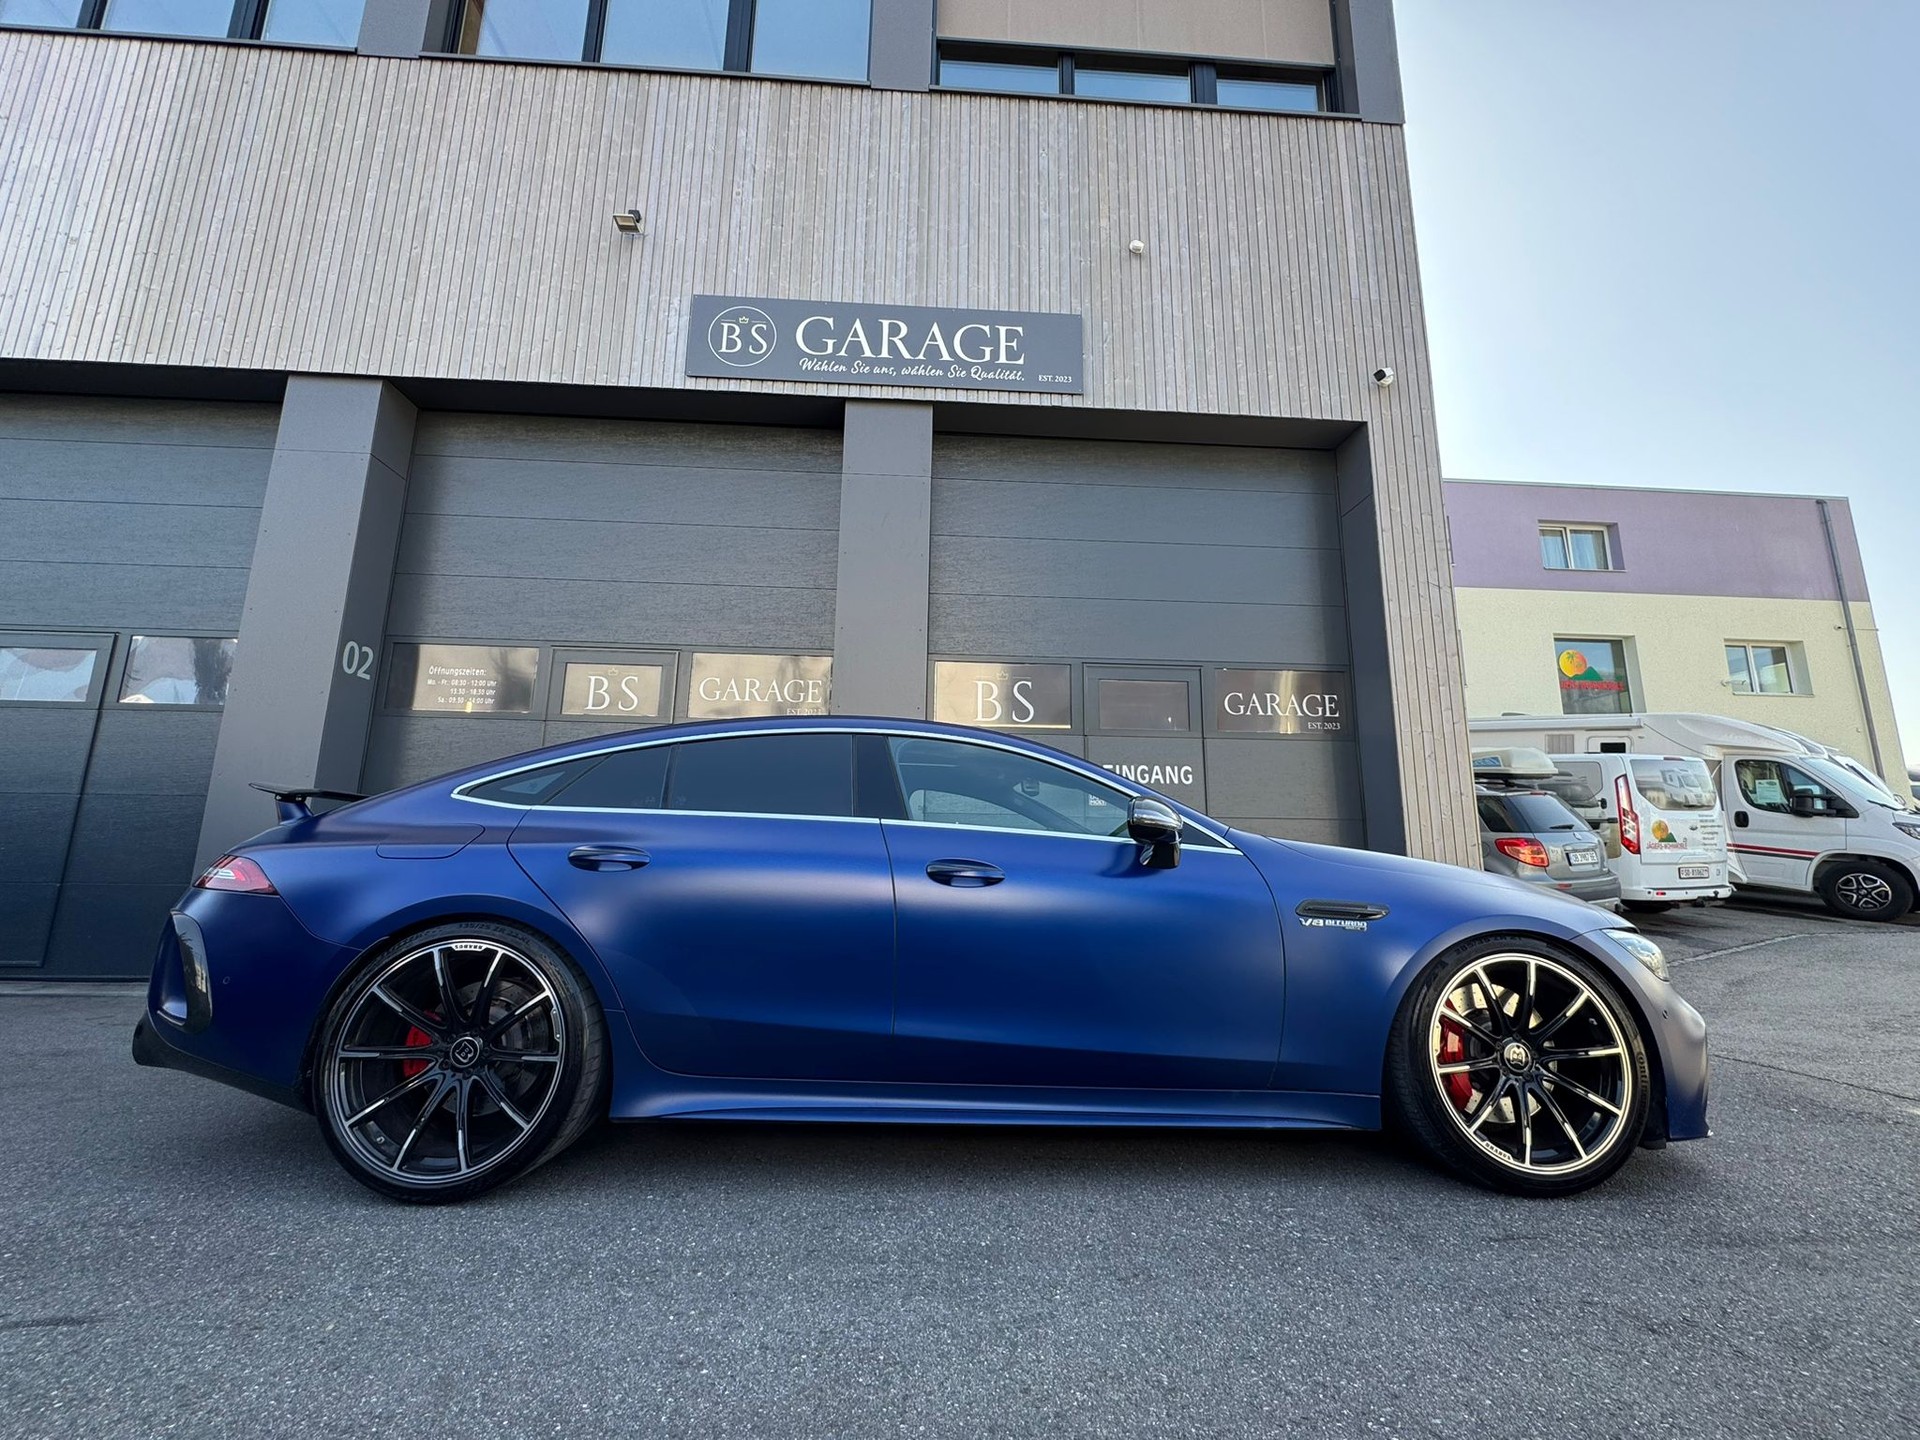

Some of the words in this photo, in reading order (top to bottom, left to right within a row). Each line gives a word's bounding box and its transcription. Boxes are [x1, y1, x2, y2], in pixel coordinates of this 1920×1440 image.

[795, 316, 1025, 365] GARAGE
[799, 357, 848, 373] Wählen
[851, 360, 871, 374] Sie
[873, 365, 897, 376] uns,
[901, 364, 944, 377] wählen
[948, 364, 967, 378] Sie
[970, 365, 1025, 381] Qualität.
[1038, 374, 1054, 382] EST.
[1054, 374, 1073, 383] 2023
[342, 640, 374, 681] 02
[699, 677, 822, 703] GARAGE
[1223, 692, 1340, 718] GARAGE
[1323, 722, 1341, 730] 2023
[1102, 764, 1193, 785] INGANG
